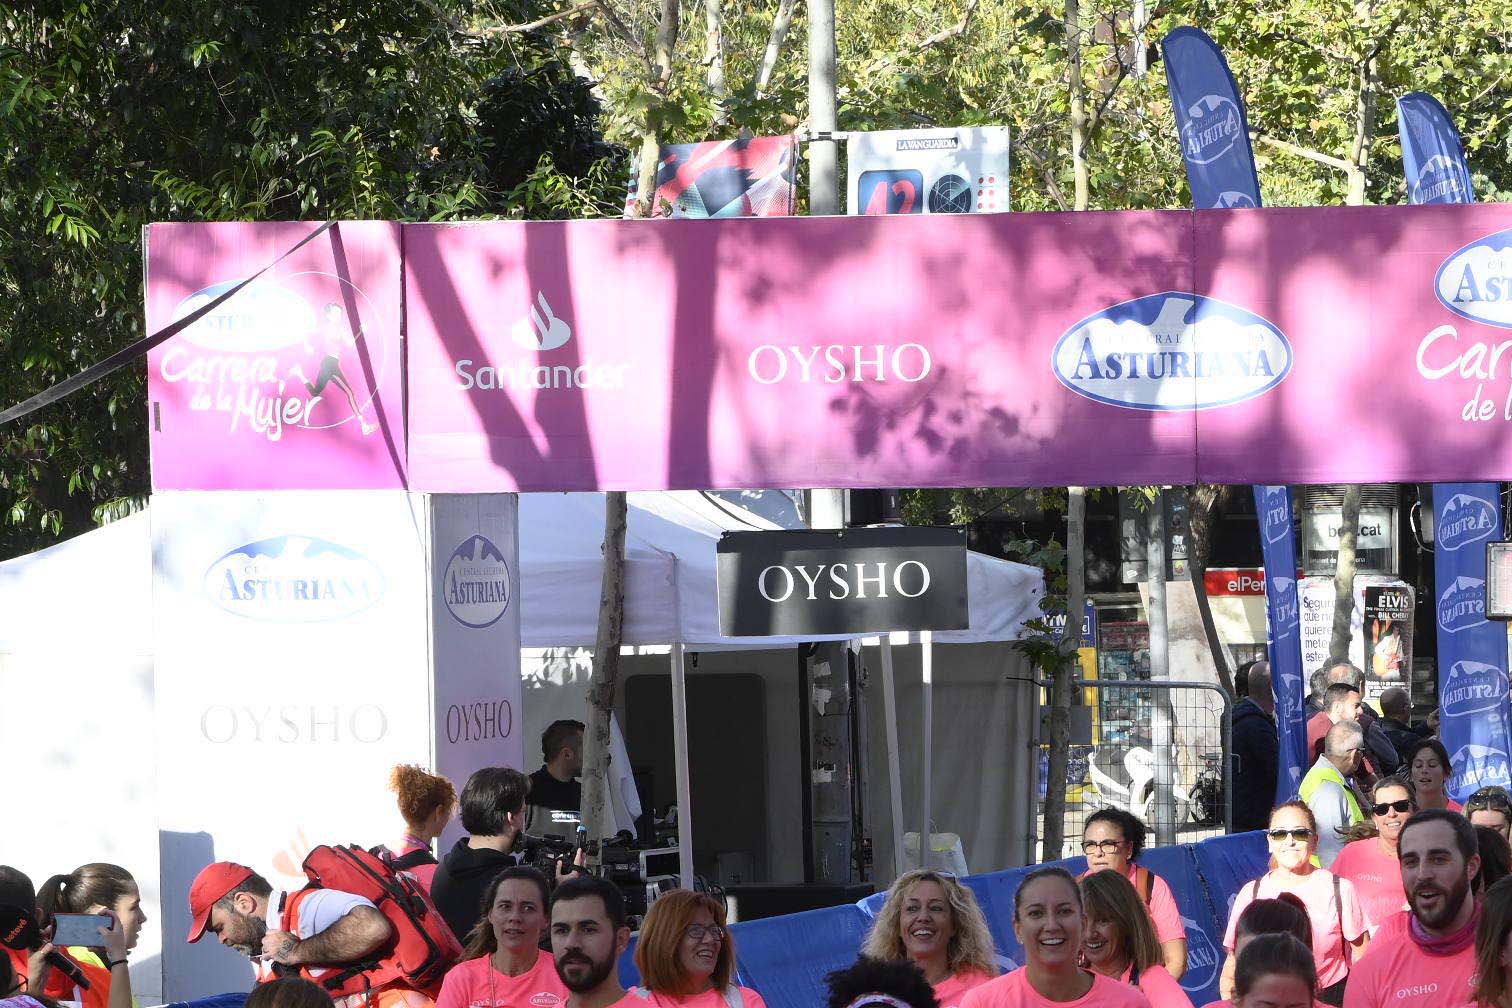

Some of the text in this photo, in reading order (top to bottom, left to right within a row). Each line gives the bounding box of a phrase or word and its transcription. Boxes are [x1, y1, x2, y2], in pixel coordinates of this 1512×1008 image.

[160, 347, 277, 384] Carrera
[456, 360, 630, 391] Santander
[748, 343, 932, 385] OYSHO
[1071, 336, 1274, 379] ASTURIANA
[189, 380, 324, 441] de la Mujer
[1461, 384, 1496, 421] de
[1328, 523, 1381, 538] b.cat
[448, 571, 506, 605] ASTURIANA
[758, 558, 931, 602] OYSHO
[1379, 596, 1408, 607] ELVIS
[200, 703, 388, 744] OYSHO
[446, 700, 512, 744] OYSHO
[1397, 983, 1438, 999] OYSHO
